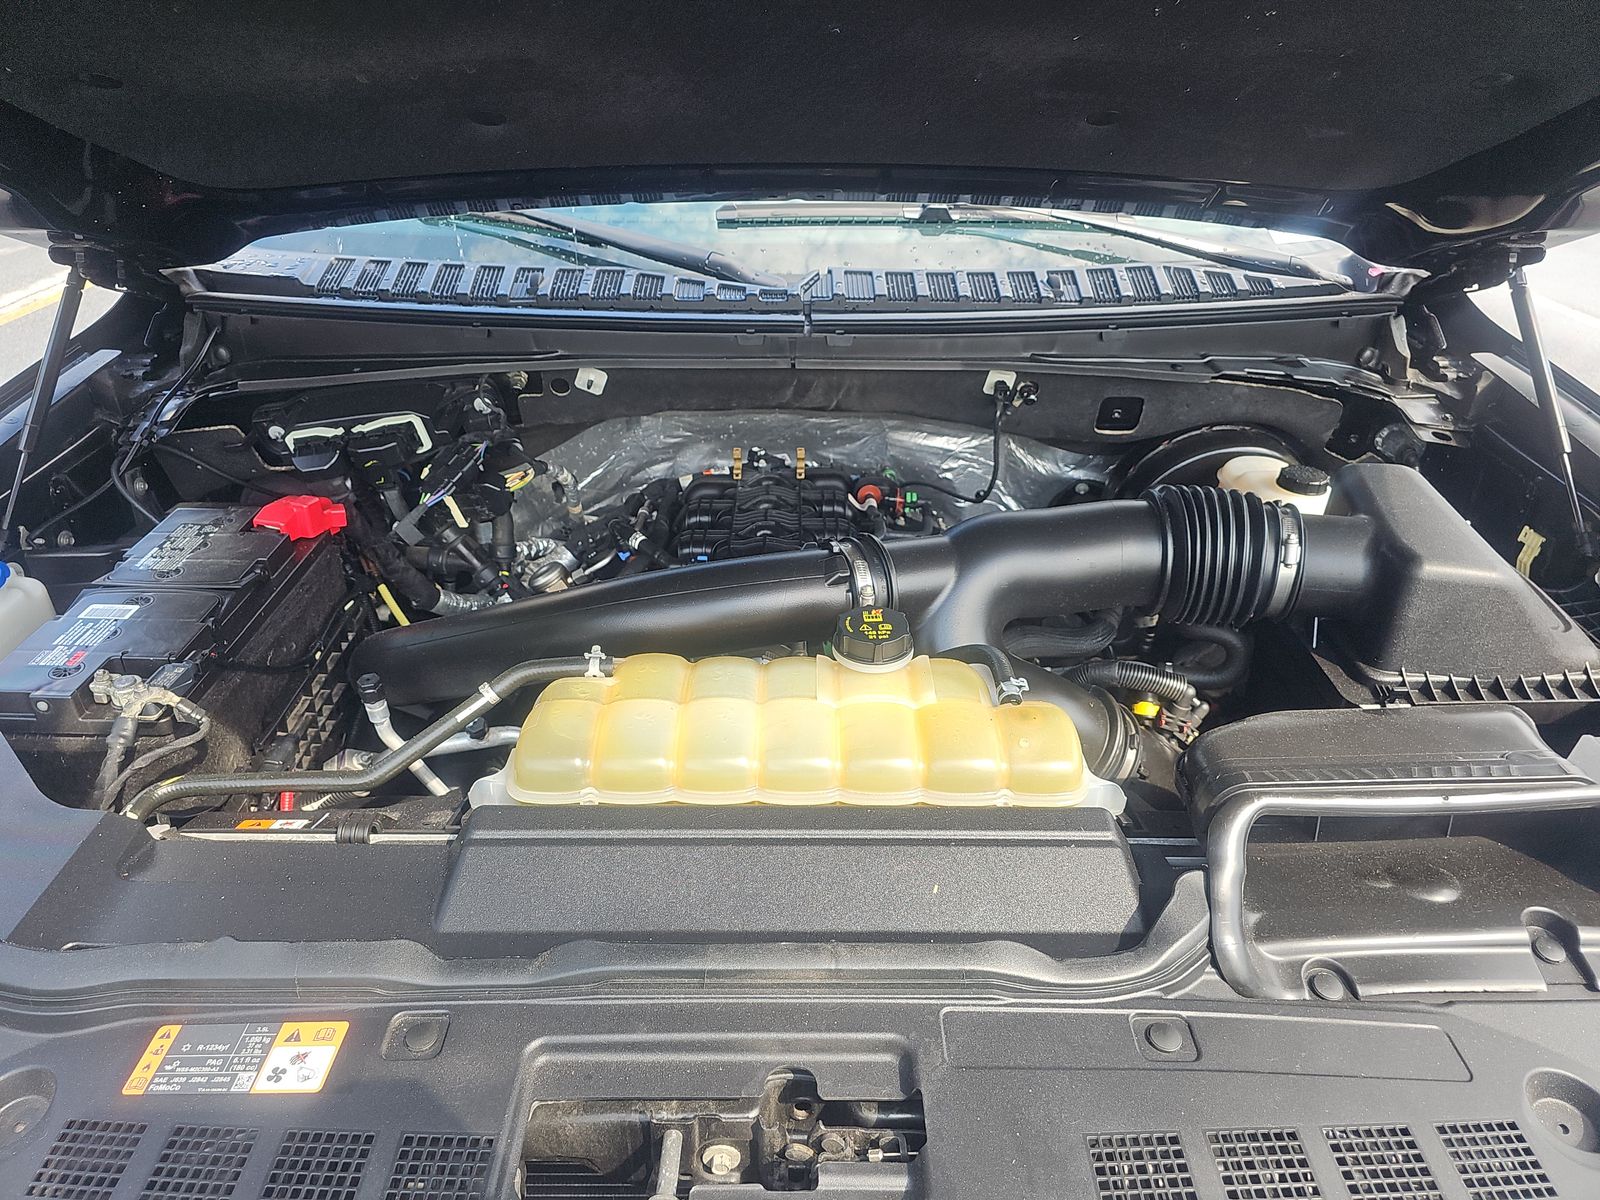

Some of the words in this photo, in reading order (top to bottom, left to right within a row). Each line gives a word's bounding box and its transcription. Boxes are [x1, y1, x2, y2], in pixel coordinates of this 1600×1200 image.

[262, 1036, 271, 1044] kg
[196, 1043, 231, 1051] R-1234yf
[206, 1058, 224, 1066] PAG
